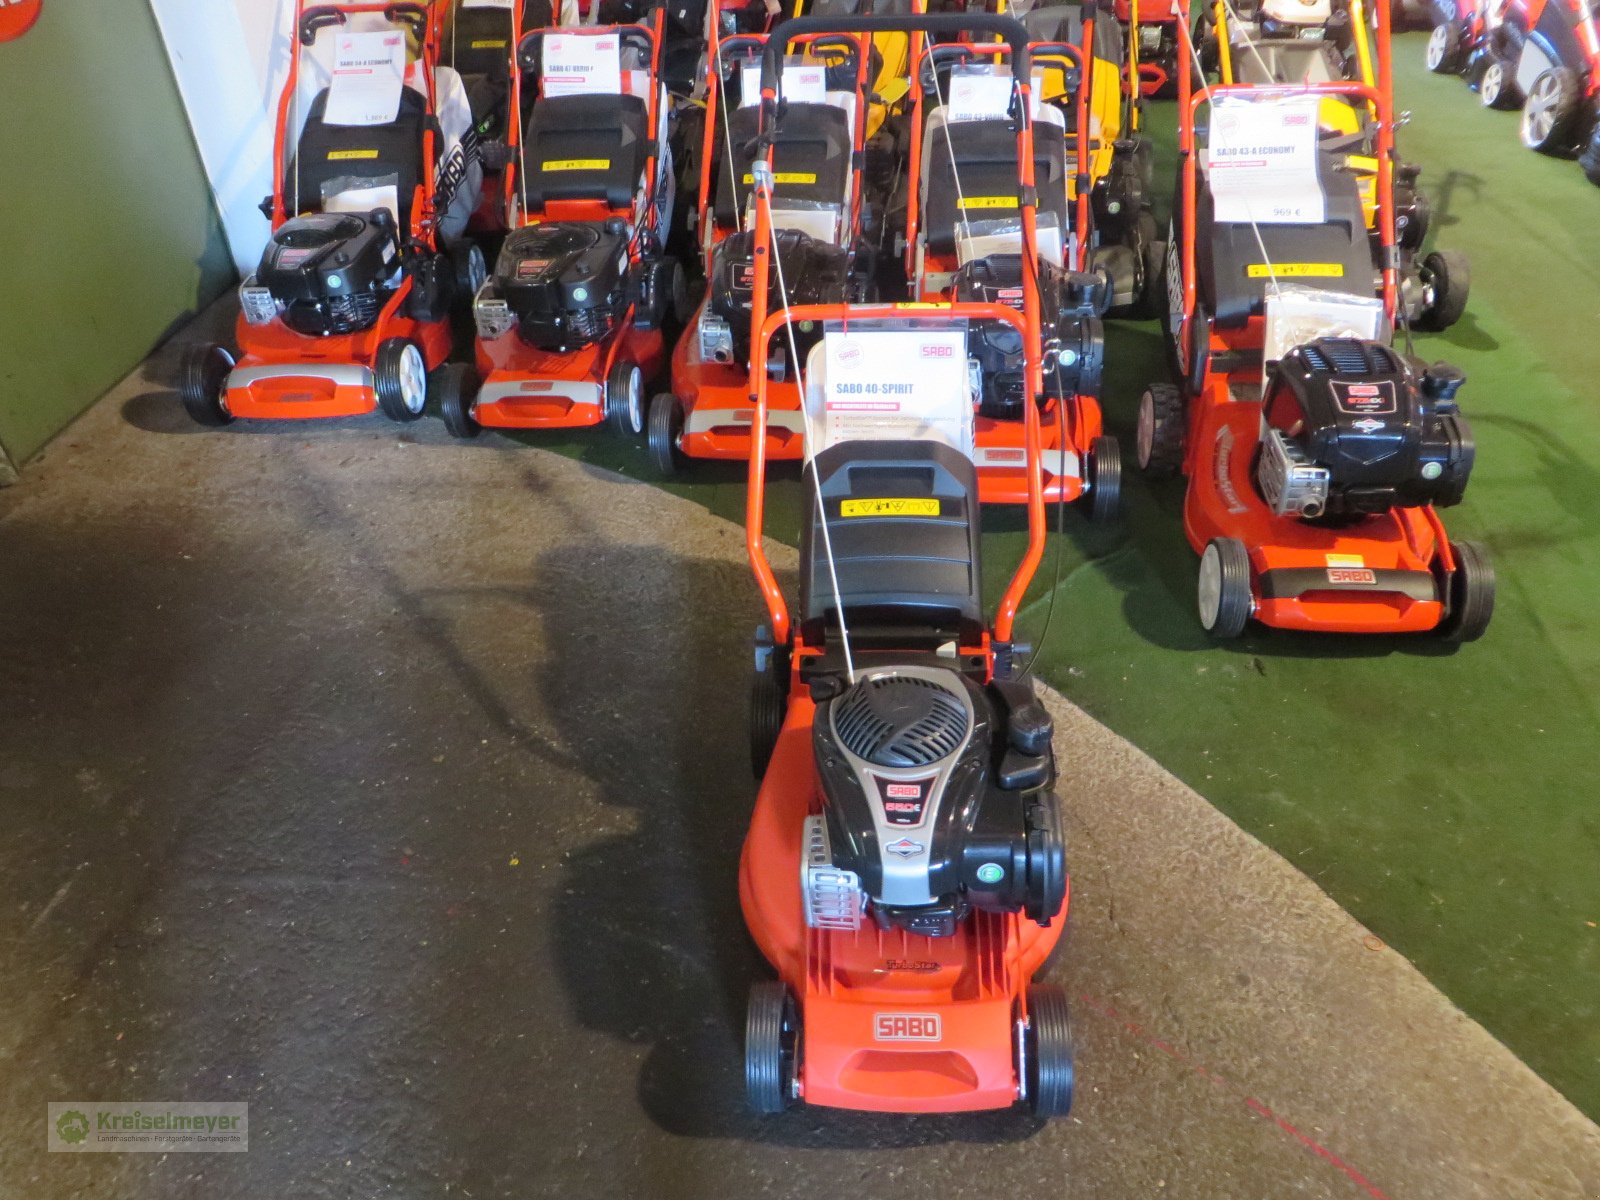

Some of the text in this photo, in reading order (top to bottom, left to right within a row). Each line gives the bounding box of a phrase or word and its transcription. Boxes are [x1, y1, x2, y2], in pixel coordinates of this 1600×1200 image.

[1259, 146, 1295, 154] ECONOMY
[1273, 208, 1291, 216] 969
[923, 346, 952, 356] SABO
[836, 383, 914, 394] SABO 40-SPIRIT
[1331, 570, 1373, 581] SABO
[889, 787, 918, 796] SABO
[879, 1017, 937, 1037] SABO
